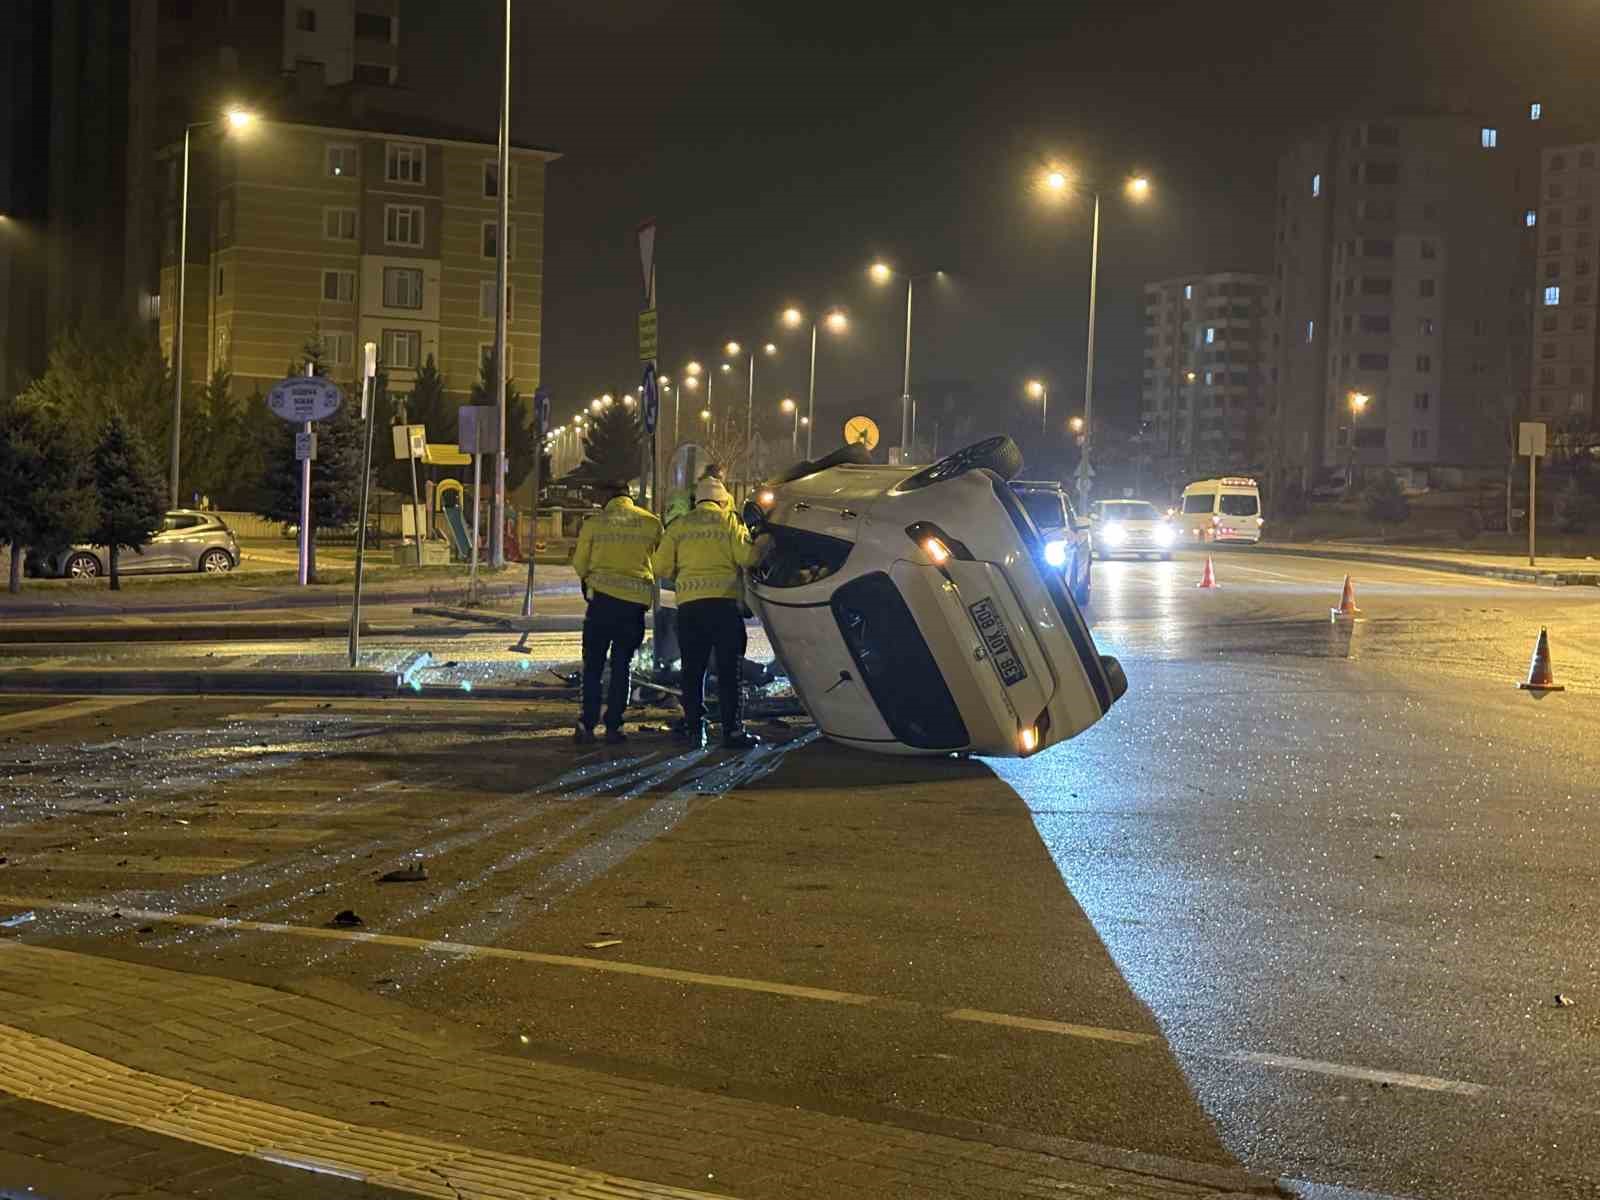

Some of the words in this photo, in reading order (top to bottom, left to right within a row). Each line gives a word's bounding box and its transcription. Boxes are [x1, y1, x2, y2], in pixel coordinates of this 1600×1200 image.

[975, 603, 995, 629] 804
[984, 630, 1009, 655] AOK
[1001, 658, 1018, 677] 38
